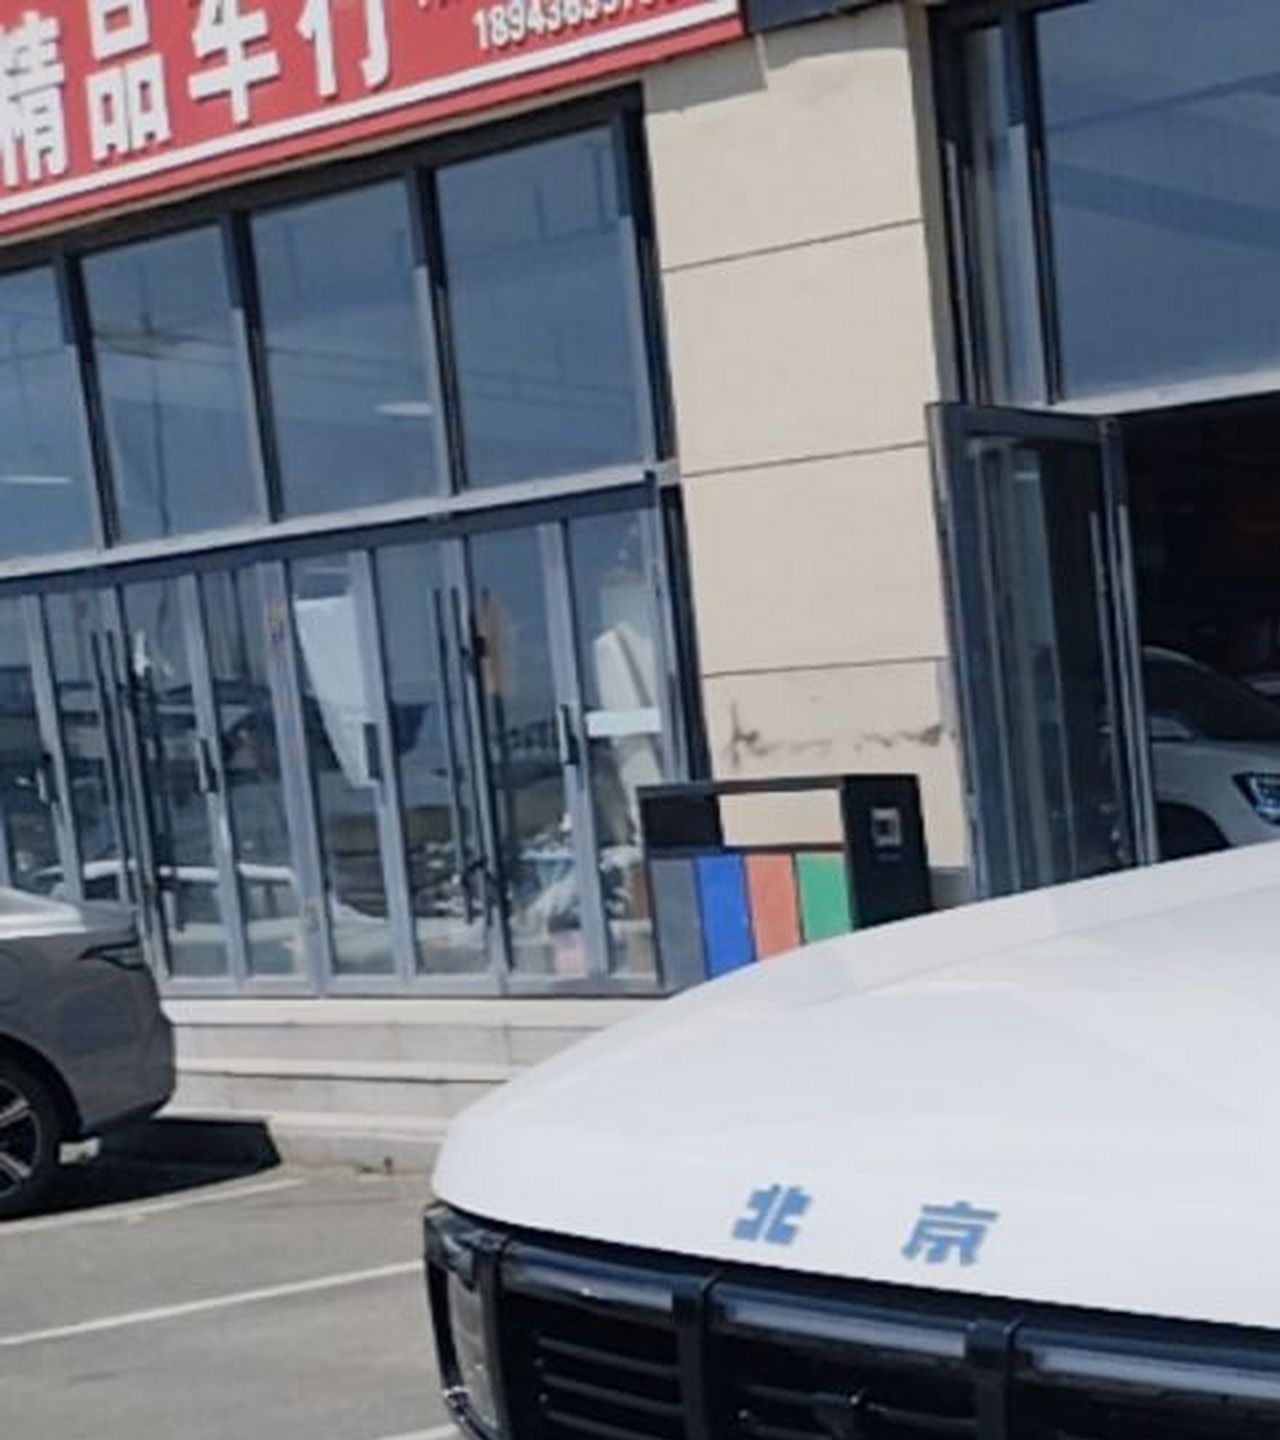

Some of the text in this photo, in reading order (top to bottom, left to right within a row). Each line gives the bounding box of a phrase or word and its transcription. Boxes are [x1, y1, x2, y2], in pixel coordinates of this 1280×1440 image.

[0, 0, 391, 188] 精品车行
[731, 1183, 1000, 1266] 北京
